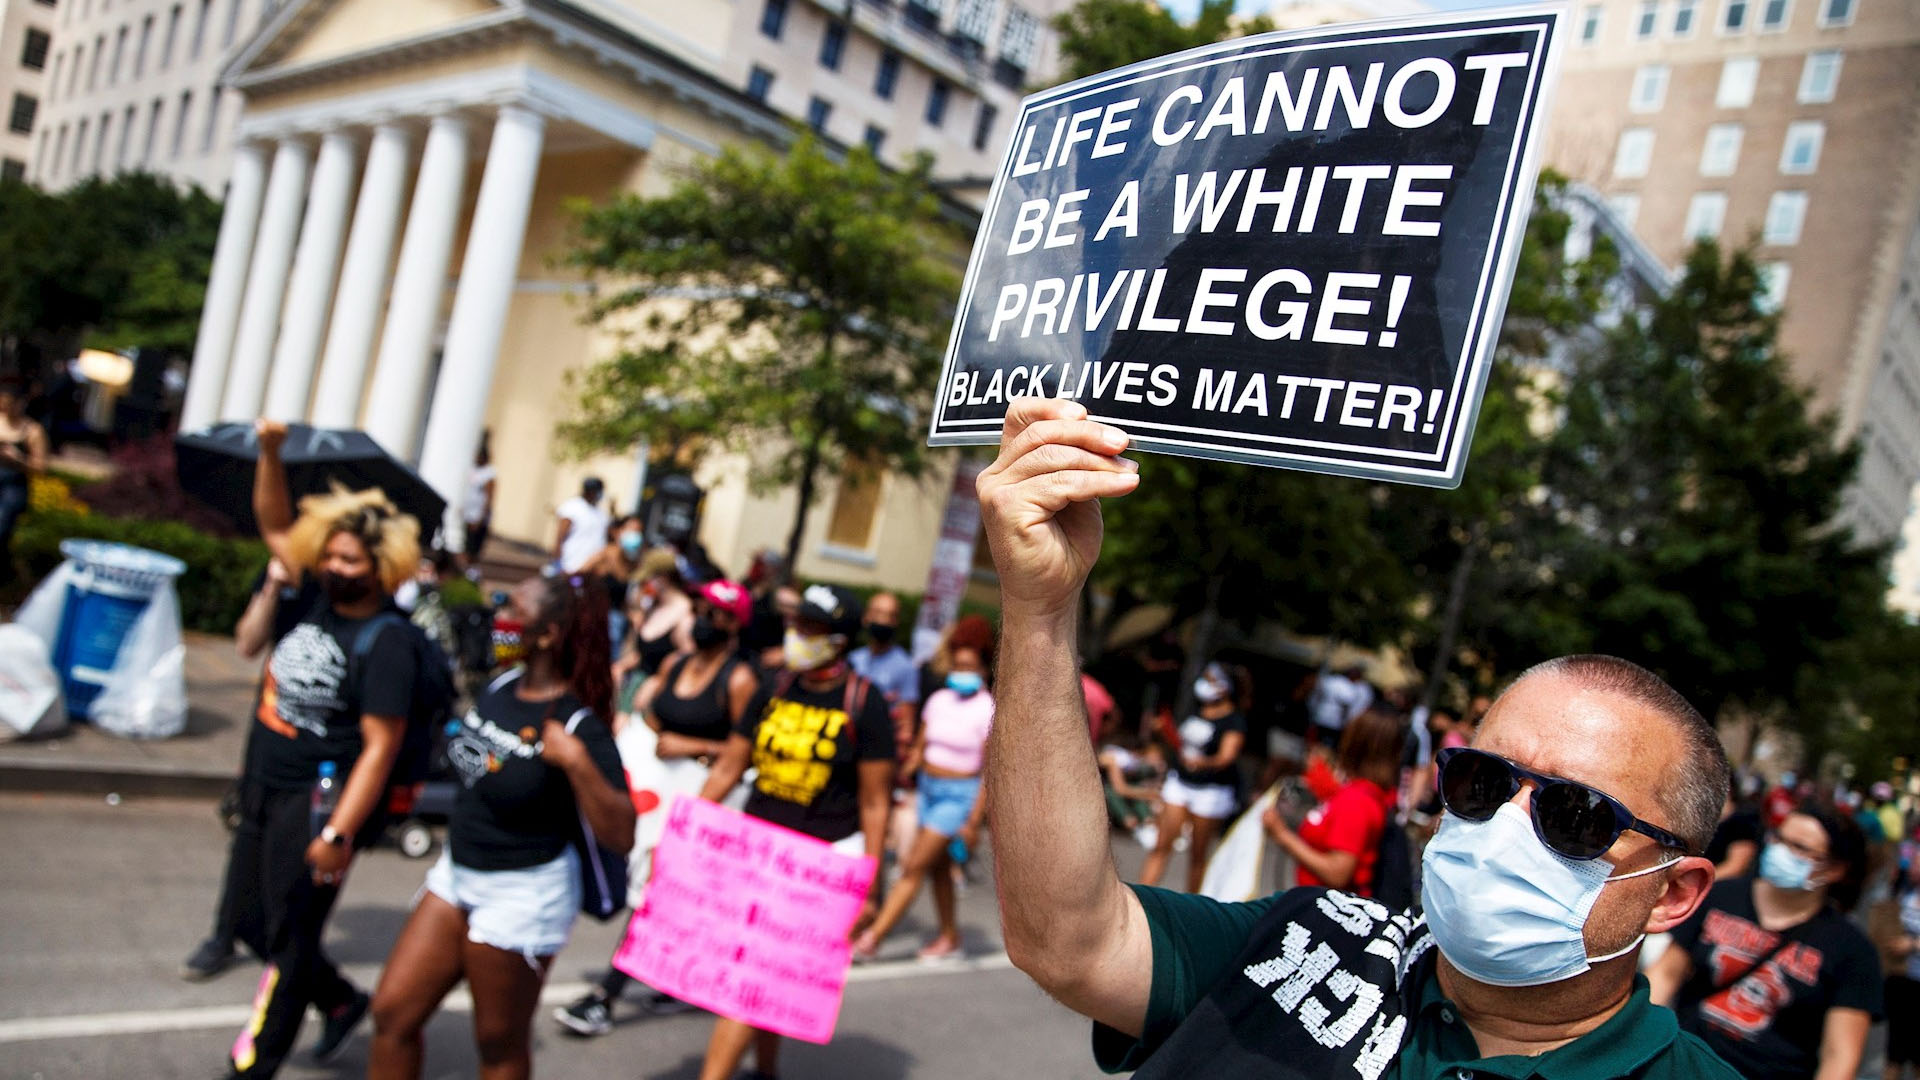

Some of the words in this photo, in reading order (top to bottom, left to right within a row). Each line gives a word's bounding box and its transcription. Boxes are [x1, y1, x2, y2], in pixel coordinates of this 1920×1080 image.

[1012, 98, 1140, 178] LIFE
[1152, 53, 1529, 147] CANNOT
[1007, 188, 1090, 256] BE
[1094, 180, 1139, 241] A
[1172, 165, 1453, 237] WHITE
[987, 269, 1412, 348] PRIVILEGE!
[948, 363, 1052, 407] BLACK
[1056, 361, 1179, 406] LIVES
[1192, 368, 1444, 434] MATTER!
